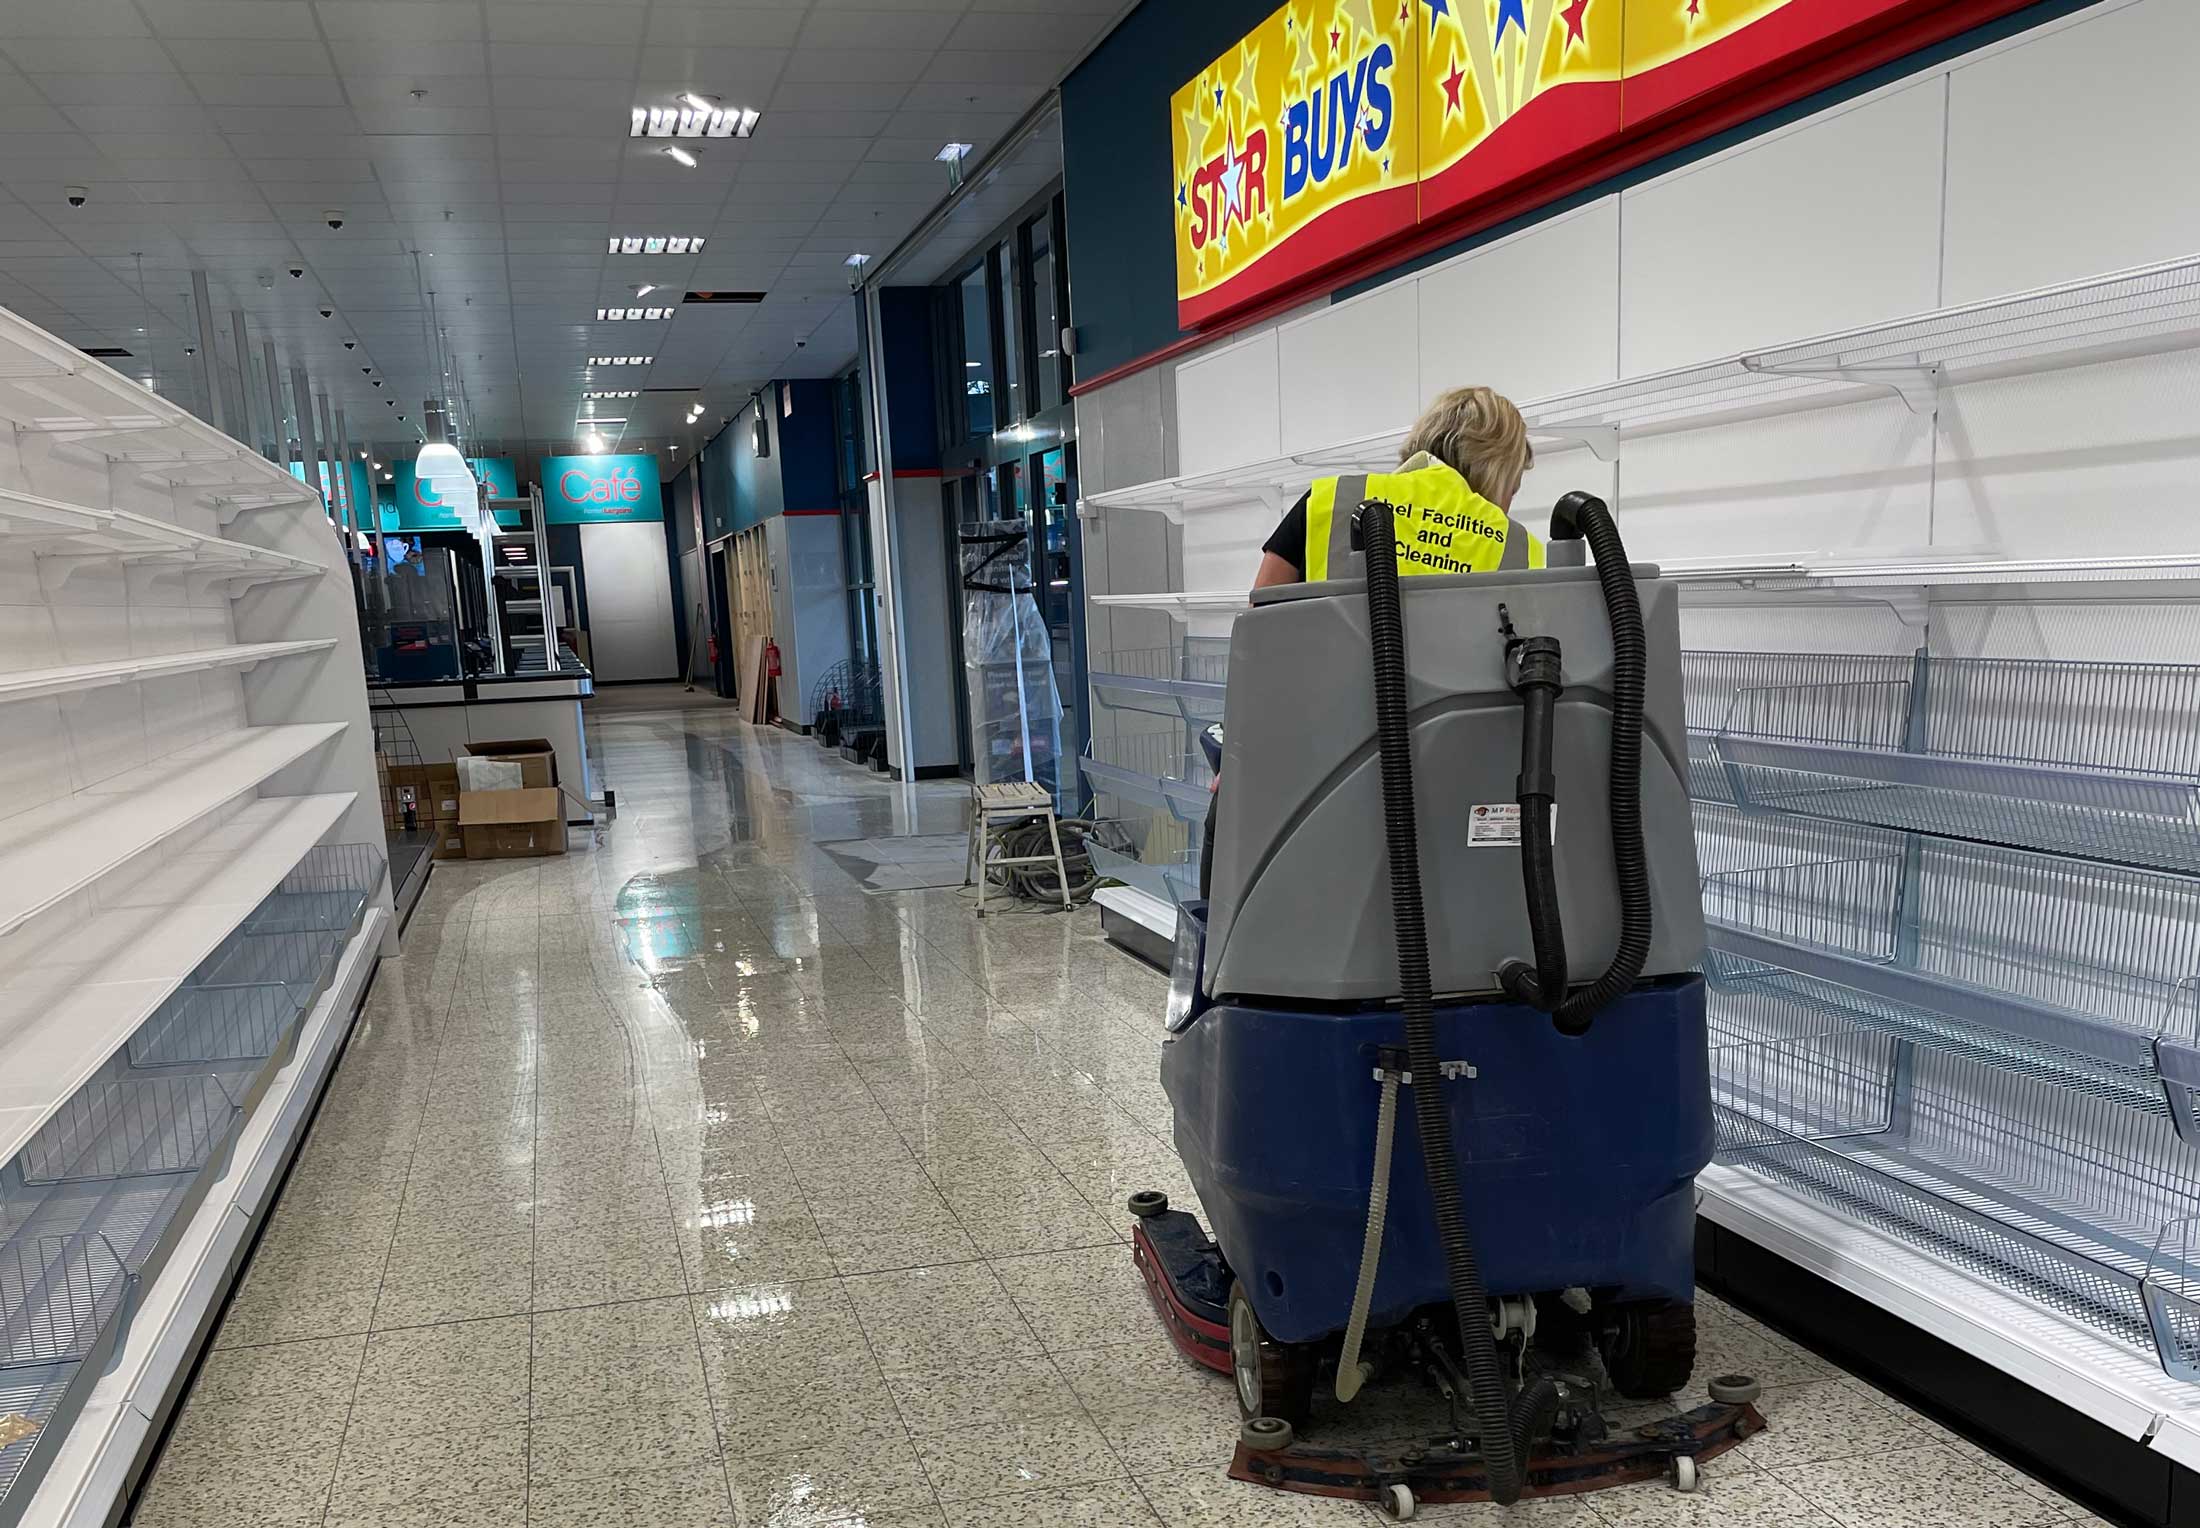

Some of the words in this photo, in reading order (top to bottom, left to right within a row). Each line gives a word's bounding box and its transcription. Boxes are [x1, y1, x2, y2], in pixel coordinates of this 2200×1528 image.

[1191, 119, 1267, 249] STAR
[1283, 43, 1393, 200] BUYS
[560, 467, 641, 503] Café
[1417, 530, 1453, 548] and
[1422, 508, 1504, 543] Facilities
